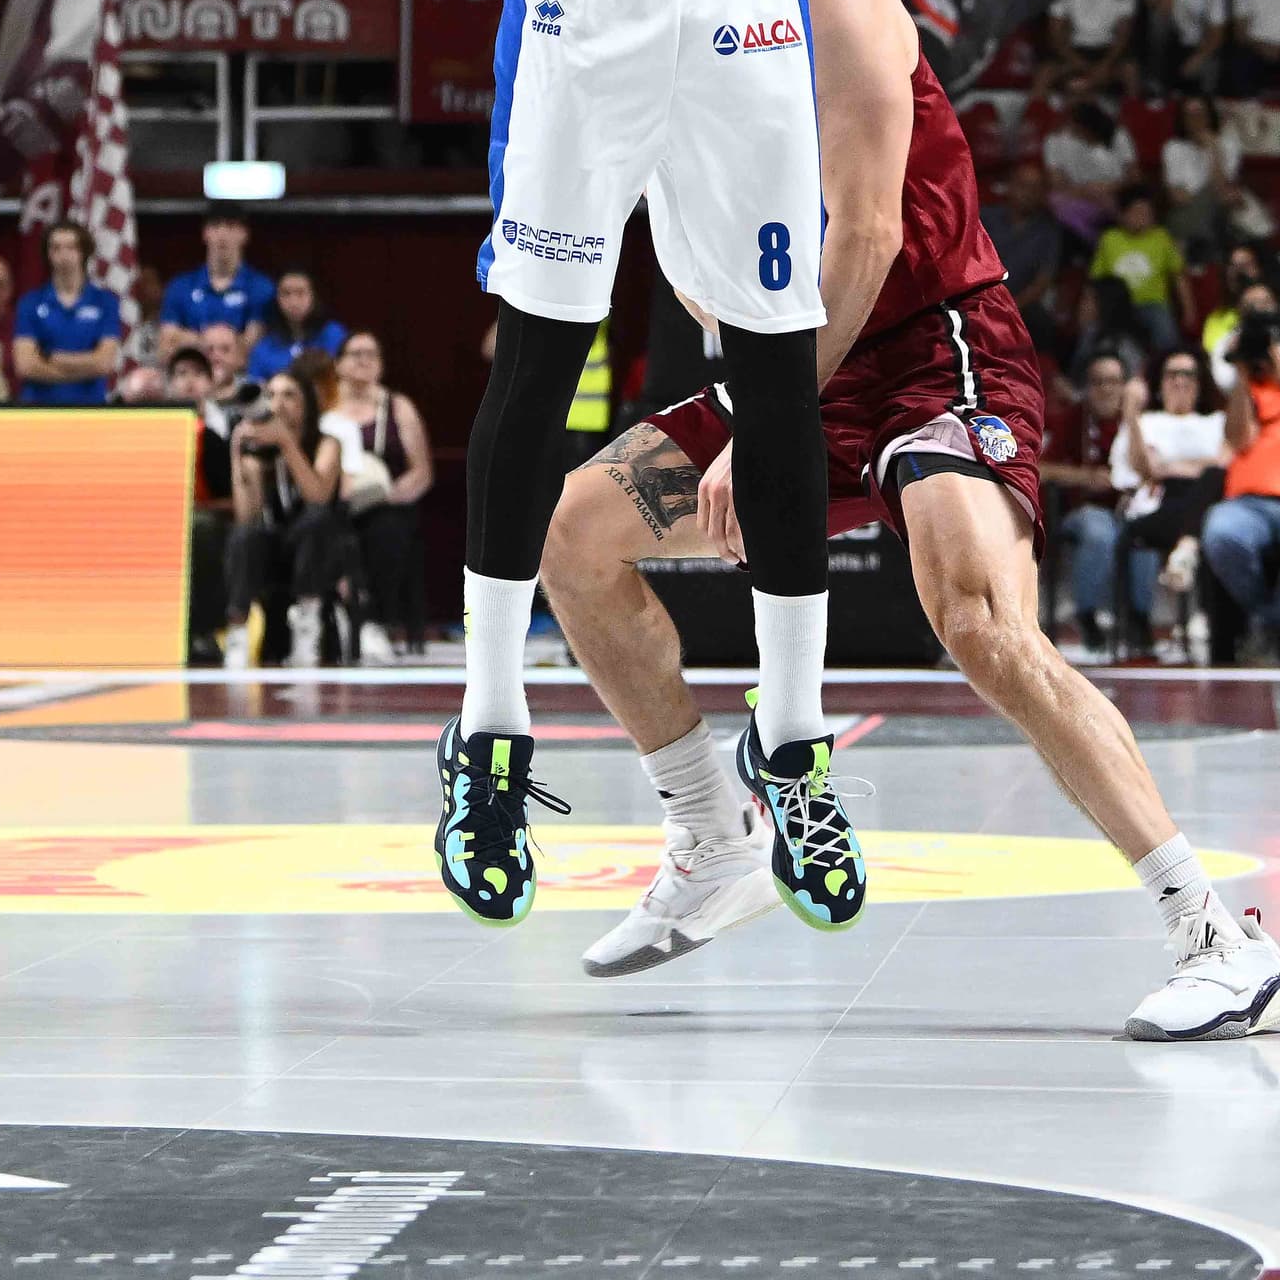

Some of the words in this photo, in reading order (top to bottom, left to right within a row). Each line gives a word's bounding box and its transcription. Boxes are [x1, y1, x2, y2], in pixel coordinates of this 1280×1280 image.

[531, 20, 562, 37] errea
[743, 18, 801, 49] ALCA
[518, 223, 605, 250] ZINCATURA
[517, 237, 603, 265] BRESCIANA
[757, 221, 793, 292] 8
